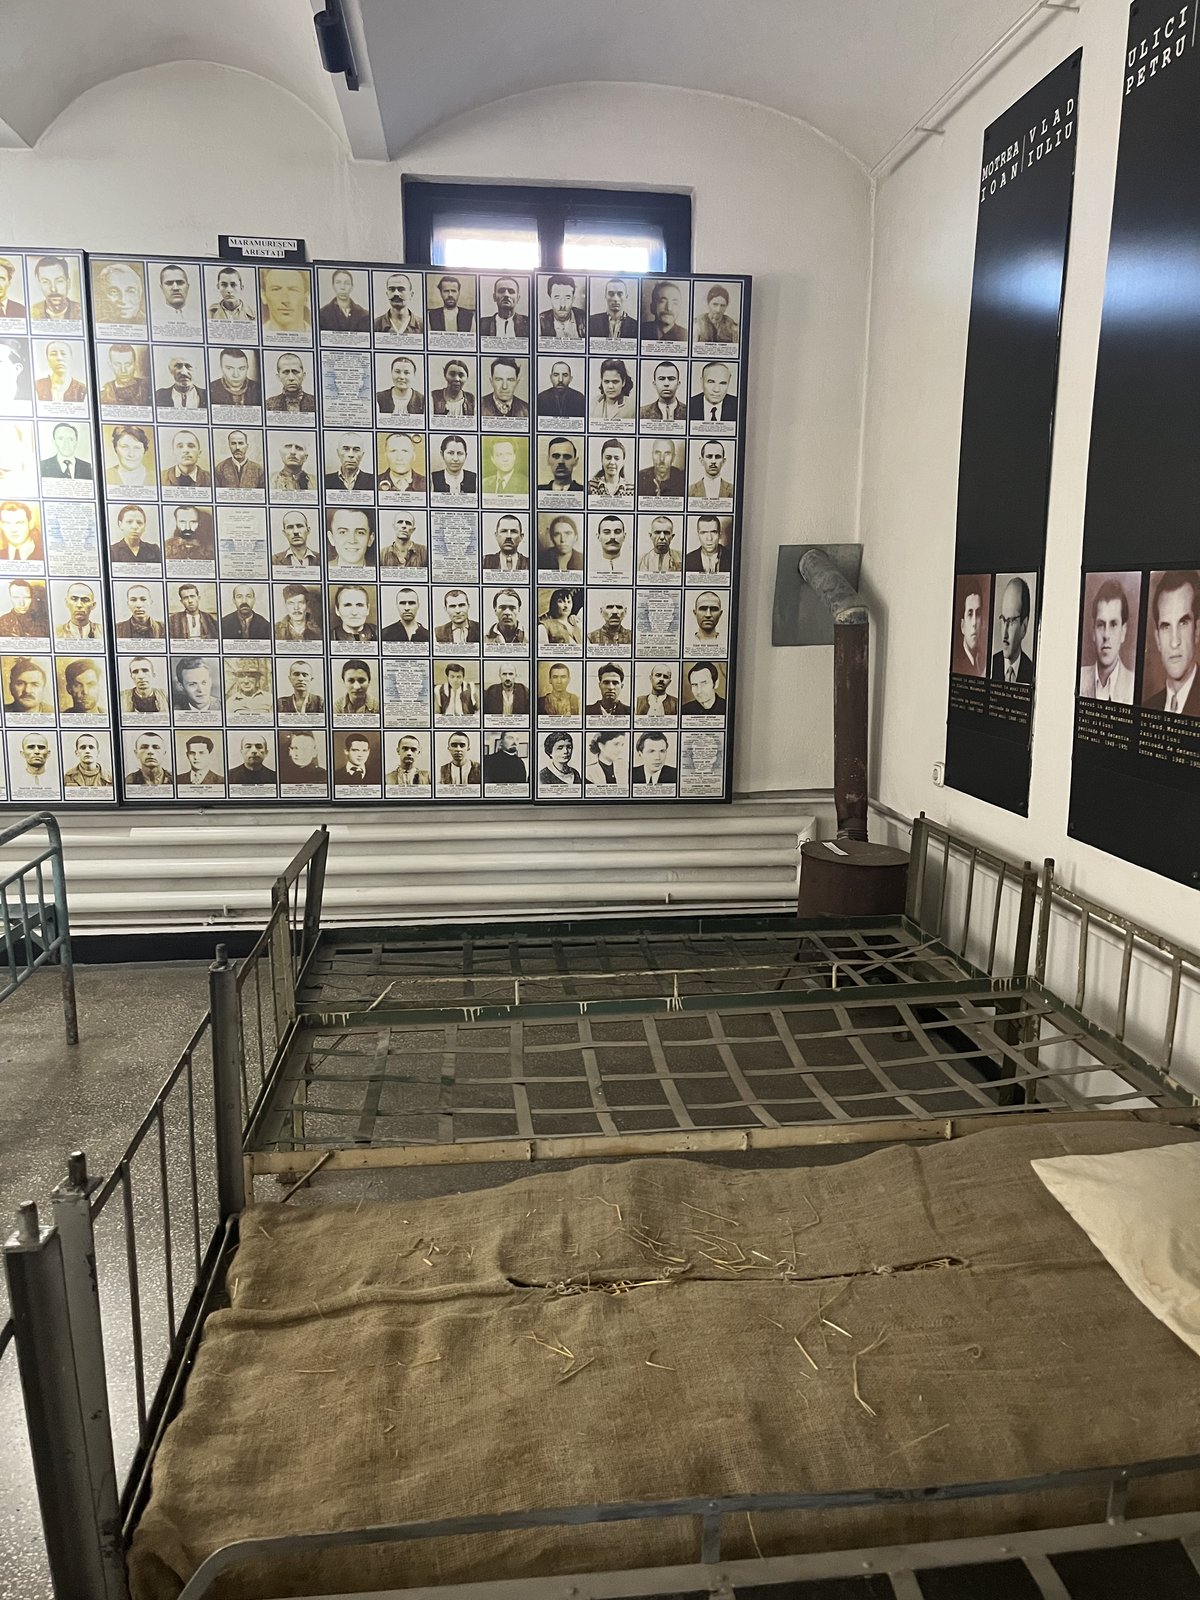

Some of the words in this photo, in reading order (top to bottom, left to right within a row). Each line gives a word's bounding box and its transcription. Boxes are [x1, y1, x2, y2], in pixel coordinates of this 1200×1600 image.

[1128, 5, 1188, 68] ULICI
[1125, 34, 1186, 96] PETRU
[1027, 120, 1074, 168] IULIU
[1028, 98, 1074, 144] VLAD
[980, 163, 1018, 202] IOAN
[982, 141, 1019, 182] MOTREA
